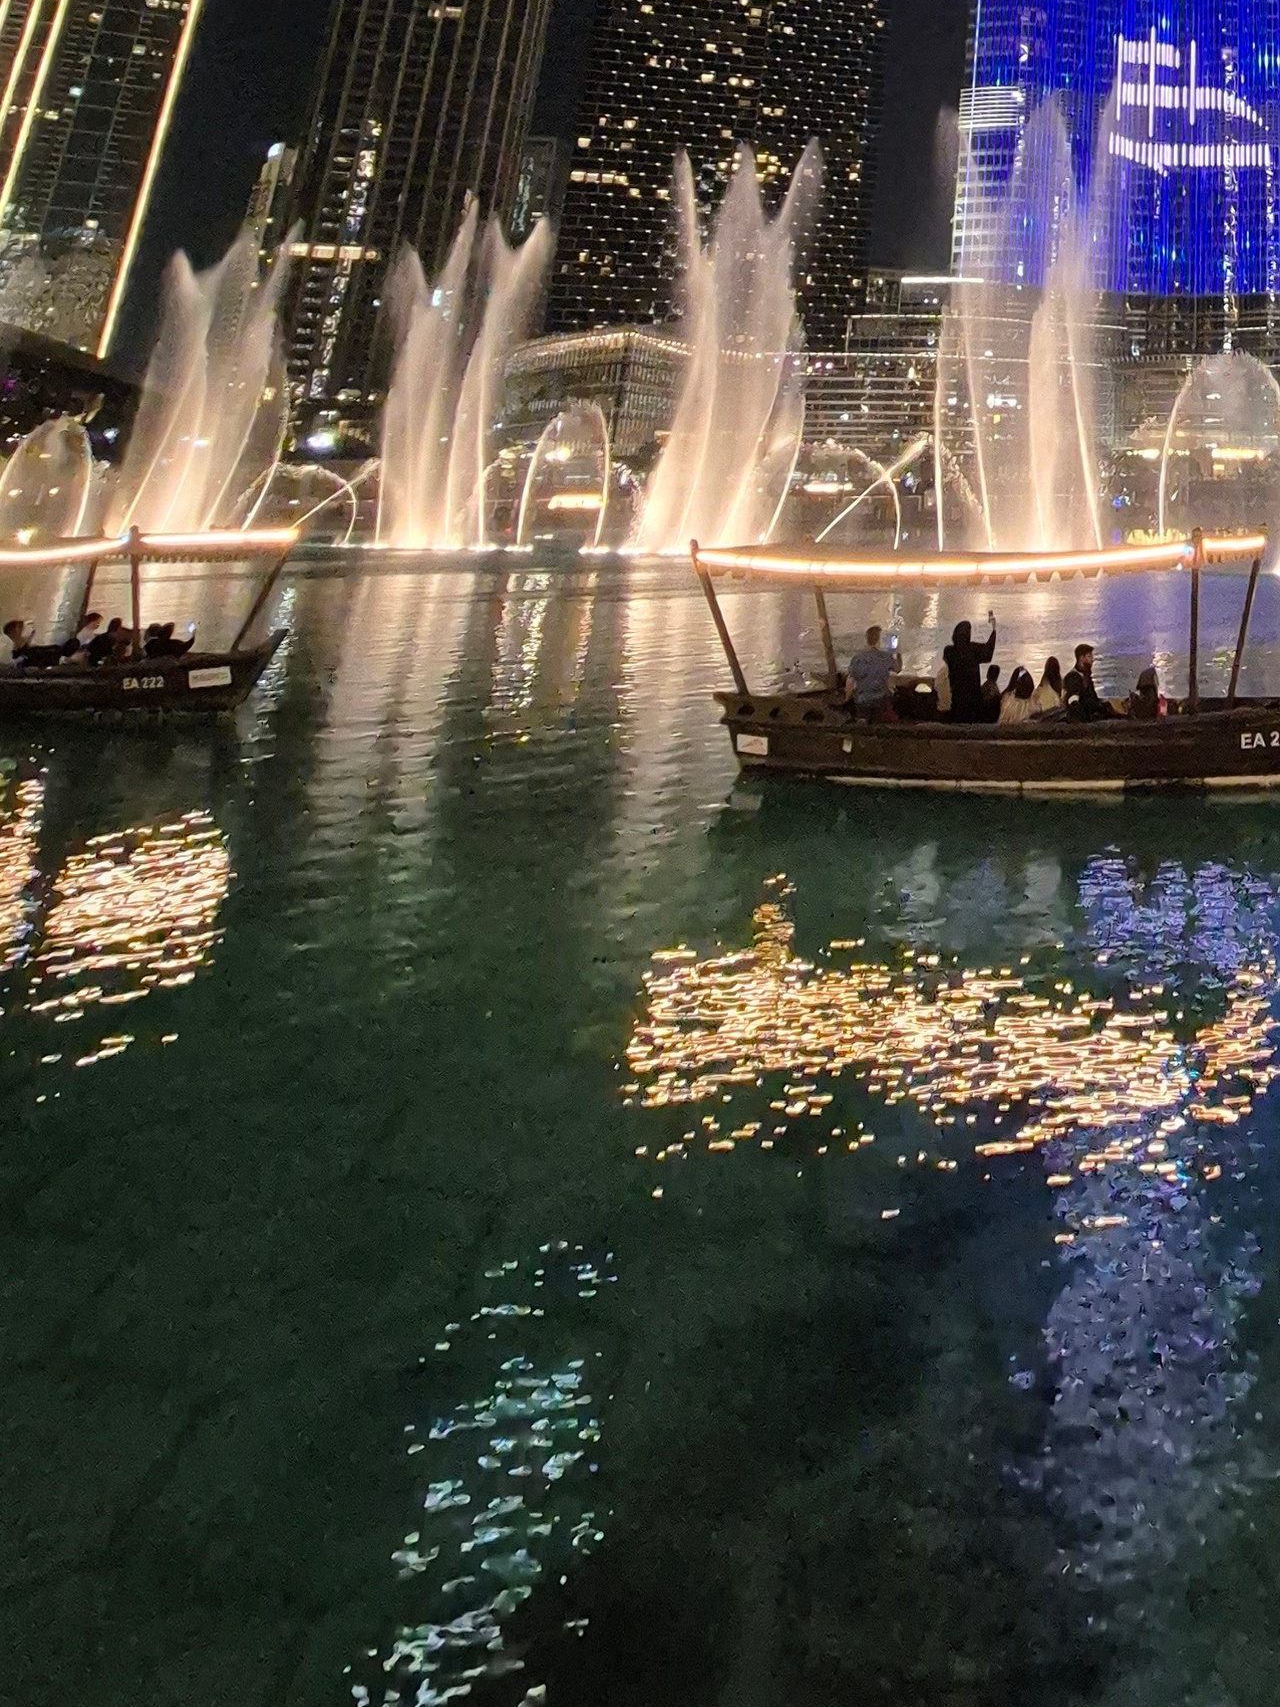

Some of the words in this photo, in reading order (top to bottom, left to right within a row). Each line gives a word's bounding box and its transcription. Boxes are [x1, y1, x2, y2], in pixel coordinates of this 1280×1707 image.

[123, 677, 139, 690] EA
[140, 675, 164, 689] 222
[1241, 732, 1266, 749] EA
